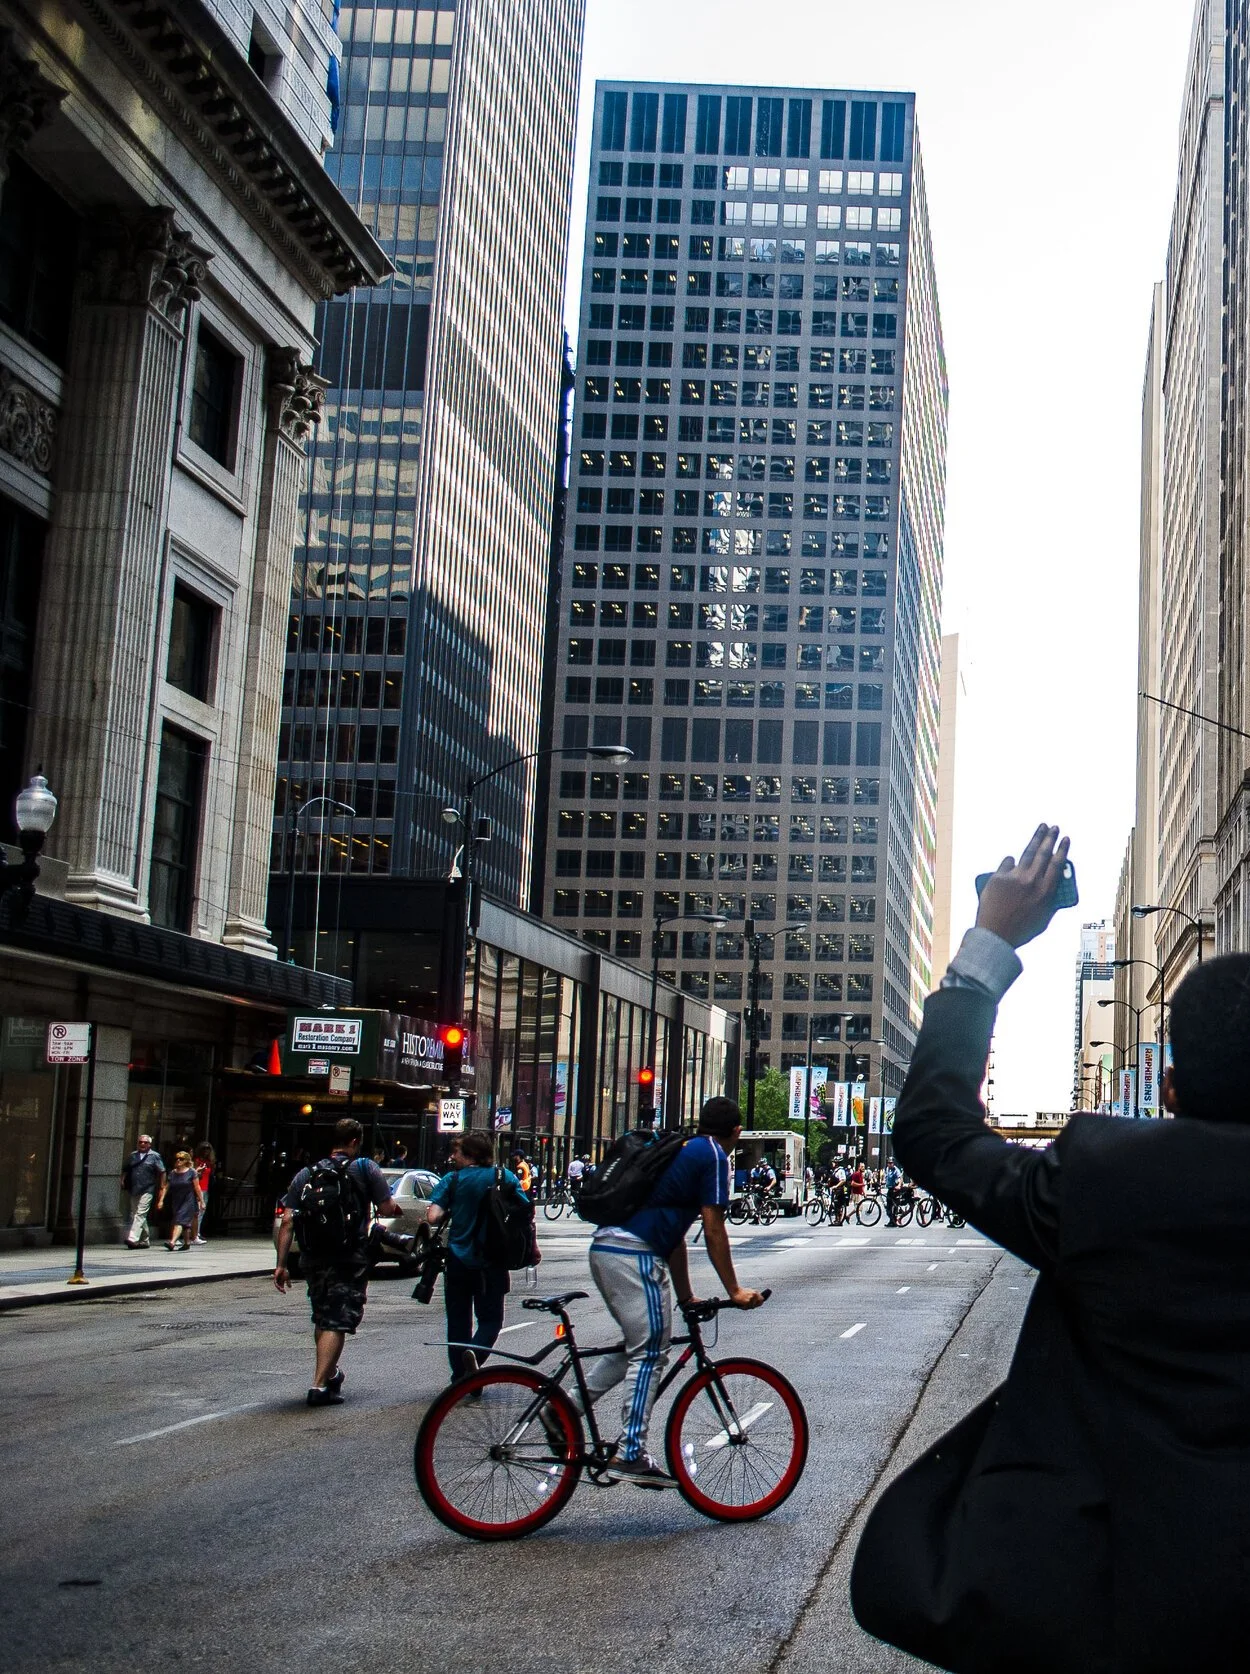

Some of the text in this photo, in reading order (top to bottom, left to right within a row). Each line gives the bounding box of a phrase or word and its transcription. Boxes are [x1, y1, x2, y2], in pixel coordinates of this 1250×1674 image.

[299, 1022, 356, 1034] MARK 1
[297, 1032, 356, 1044] Restoration Company
[443, 1102, 461, 1110] ONE
[443, 1111, 461, 1119] WAY
